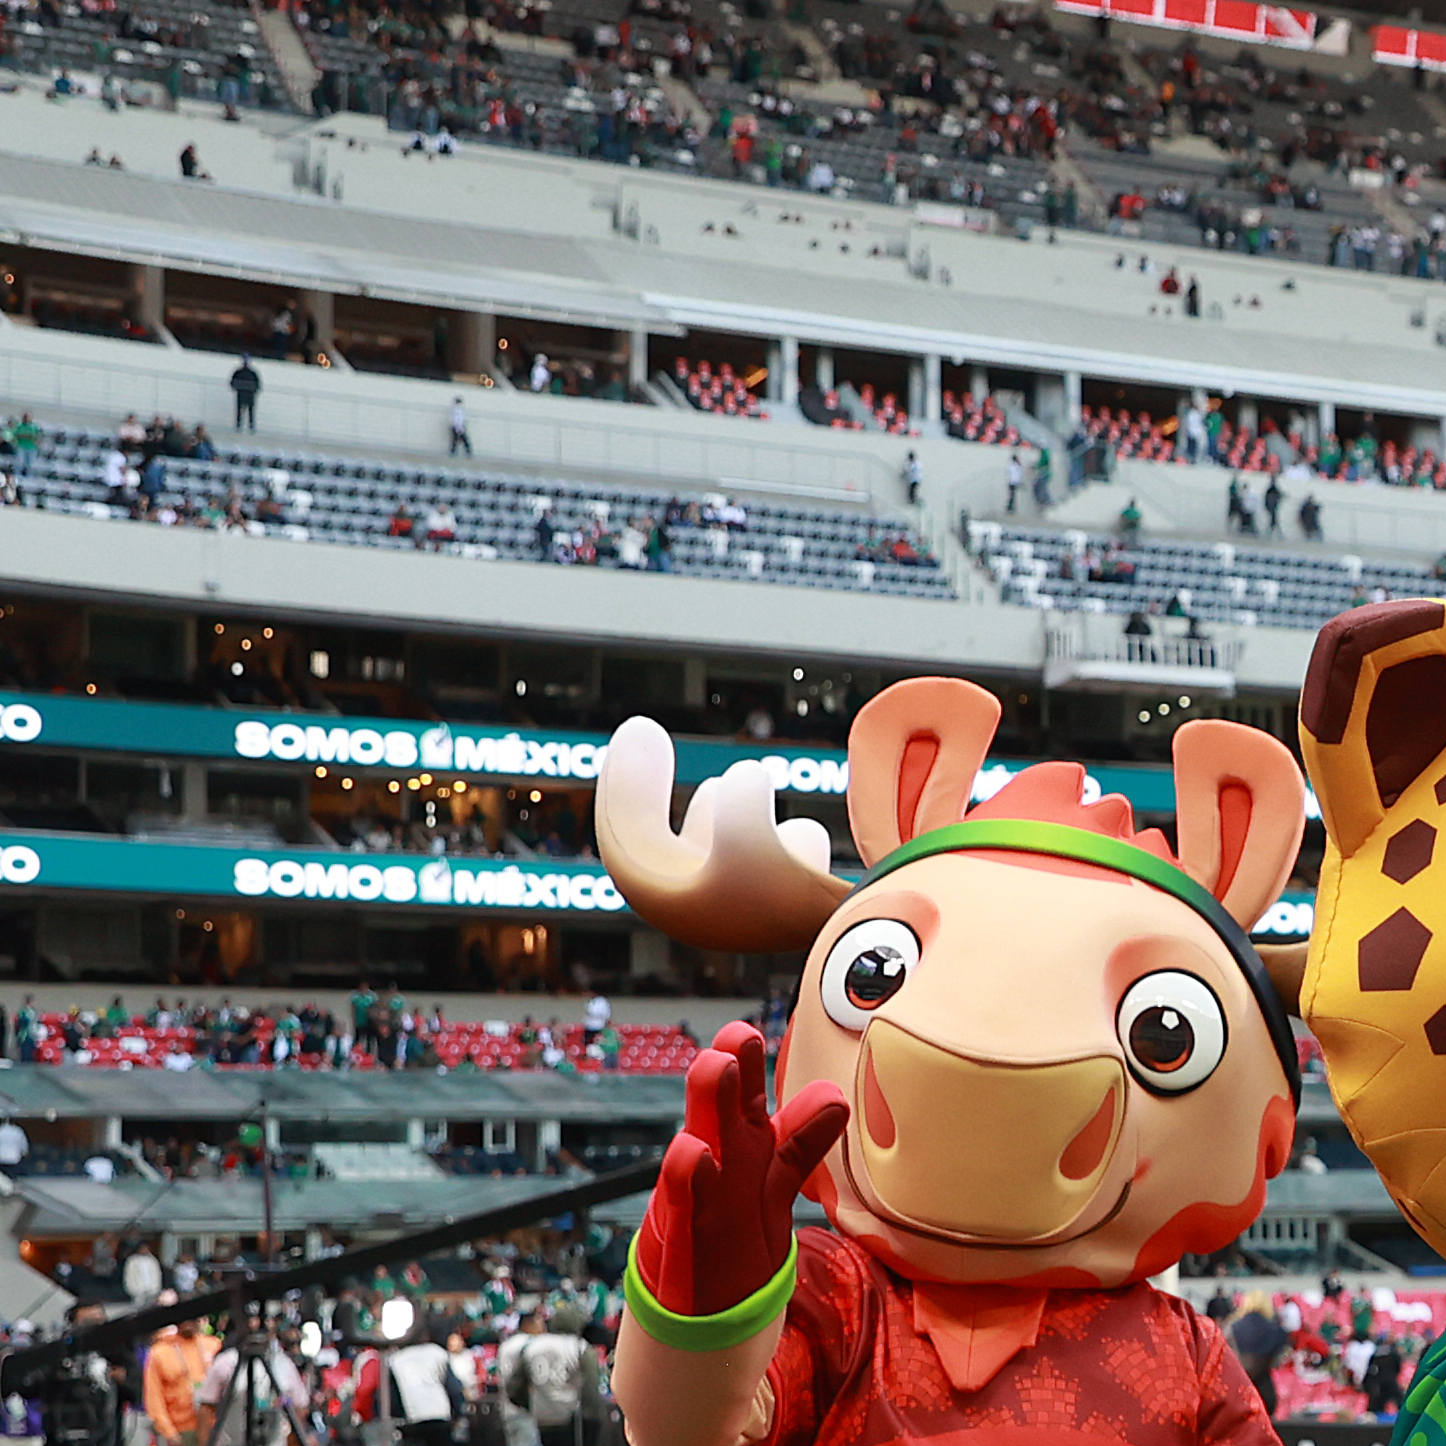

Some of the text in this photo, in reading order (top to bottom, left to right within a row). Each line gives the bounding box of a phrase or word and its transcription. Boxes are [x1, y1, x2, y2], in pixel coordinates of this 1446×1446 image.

[234, 720, 607, 779] SOMOS MÉXIC
[233, 858, 625, 911] SOMOS MÉXICO
